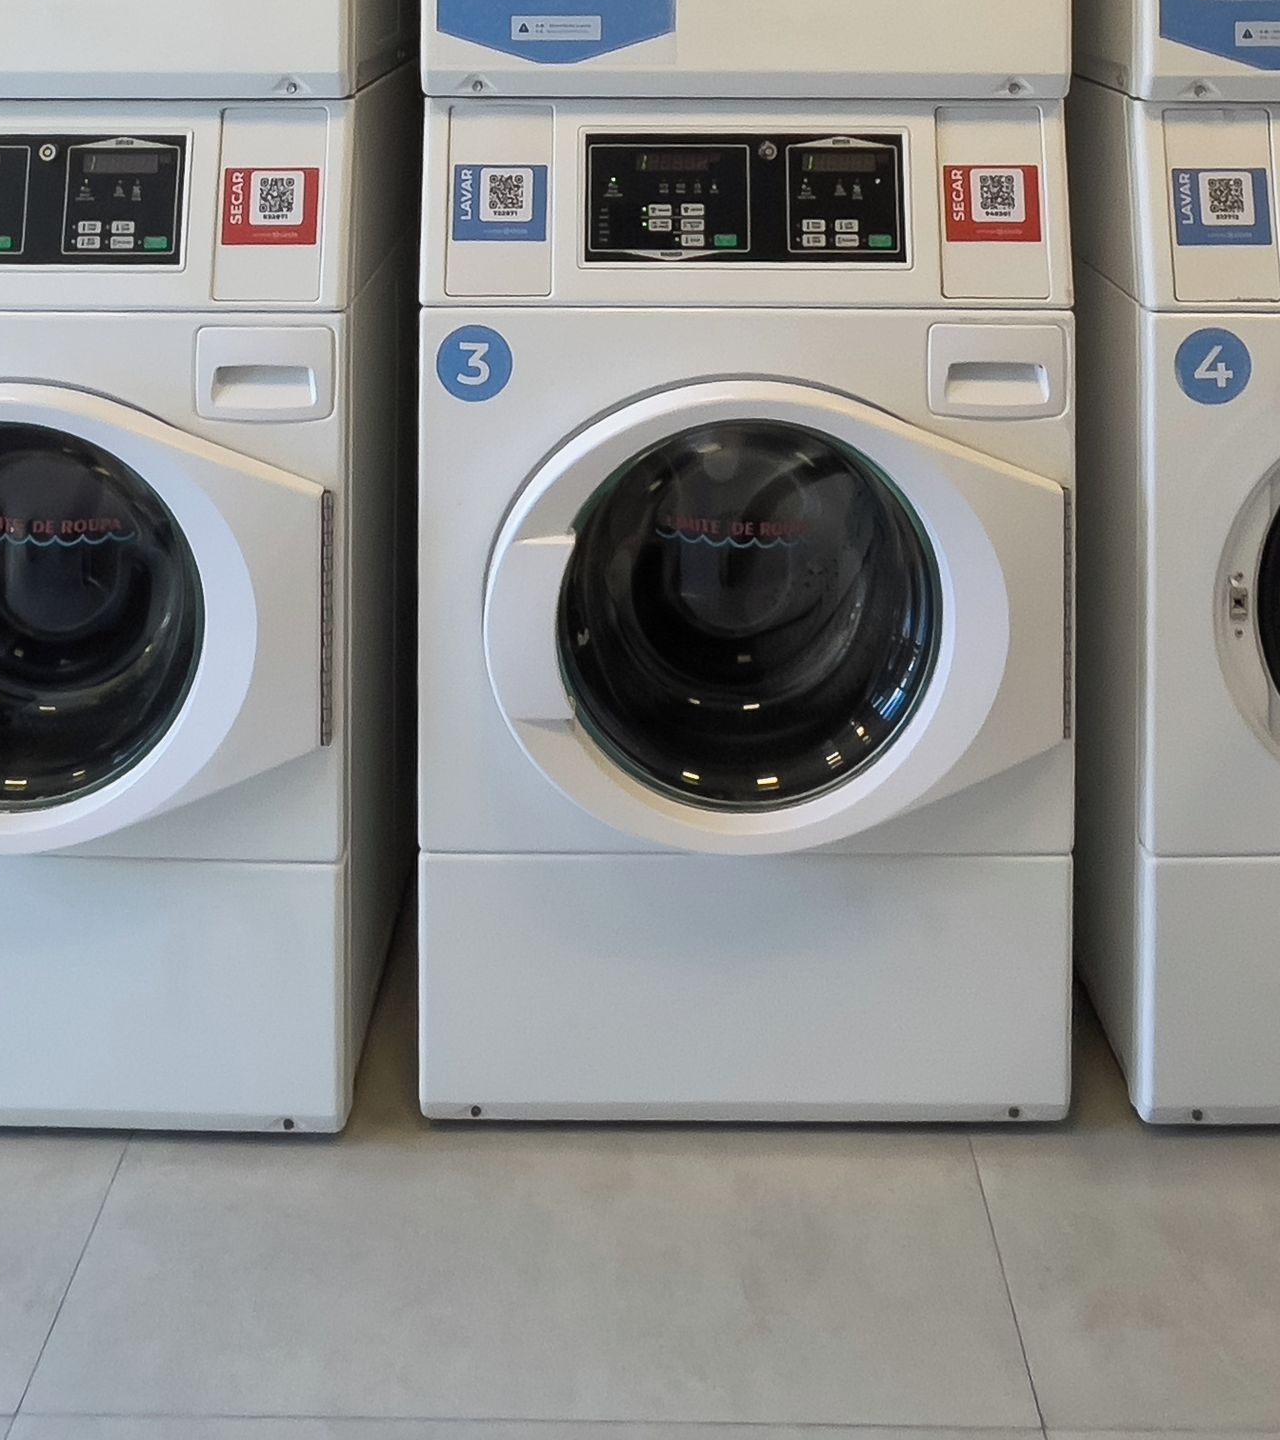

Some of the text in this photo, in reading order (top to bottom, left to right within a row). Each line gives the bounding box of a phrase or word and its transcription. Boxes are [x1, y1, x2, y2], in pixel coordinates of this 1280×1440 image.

[230, 171, 244, 224] SECAR
[460, 169, 473, 220] LAVAR
[953, 169, 964, 221] SECAR
[1179, 173, 1193, 224] LAVAR
[456, 341, 490, 386] 3
[1194, 344, 1233, 388] 4
[32, 519, 56, 535] DE
[61, 518, 121, 535] ROUPA
[732, 521, 755, 536] DE
